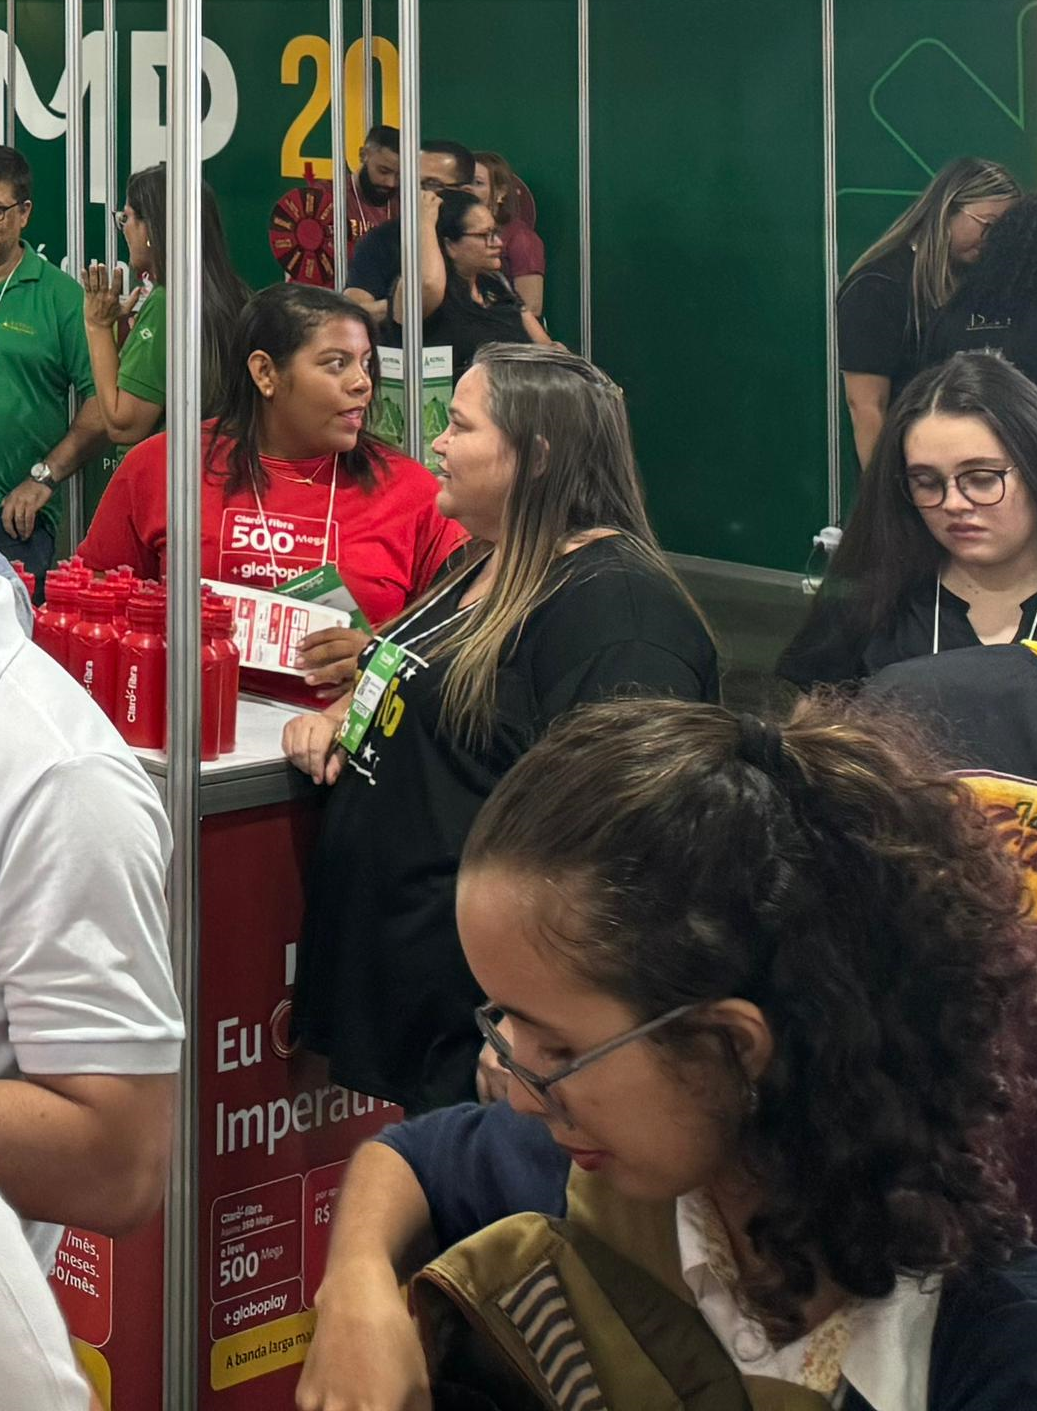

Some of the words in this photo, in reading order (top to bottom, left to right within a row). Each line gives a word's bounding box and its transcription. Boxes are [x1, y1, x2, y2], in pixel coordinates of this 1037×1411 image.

[230, 525, 295, 554] 500
[240, 561, 309, 582] globopl
[216, 1016, 262, 1074] Eu
[216, 1083, 398, 1156] Imperat
[58, 1249, 100, 1278] meses.
[219, 1251, 260, 1287] 500
[261, 1244, 284, 1261] Mega
[225, 1355, 234, 1370] A
[235, 1345, 268, 1369] banda
[268, 1335, 295, 1357] larga
